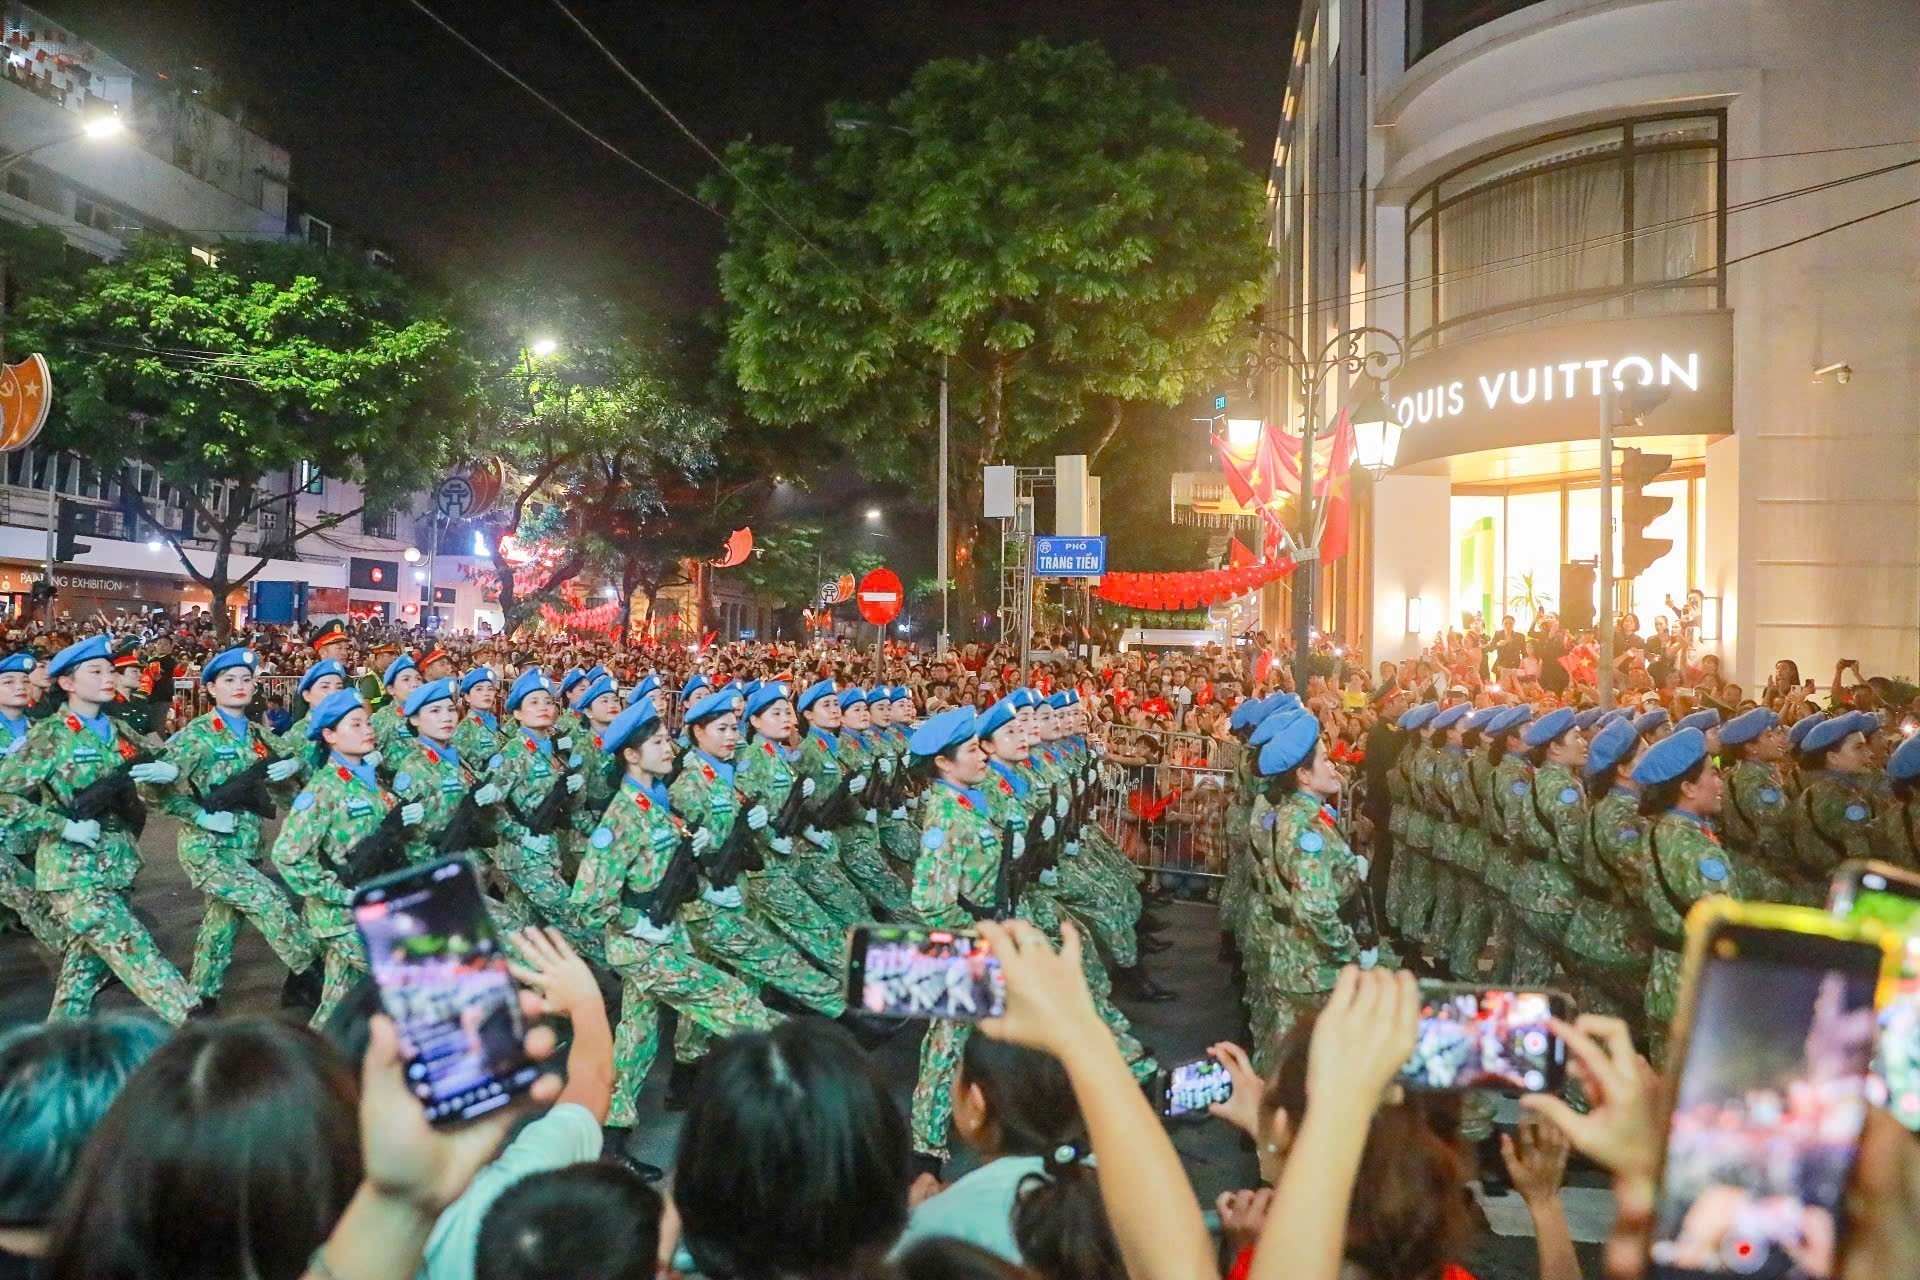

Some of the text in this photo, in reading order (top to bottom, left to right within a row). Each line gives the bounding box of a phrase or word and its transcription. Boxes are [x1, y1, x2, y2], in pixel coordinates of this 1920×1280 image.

[1392, 353, 1698, 429] OUIS VUITTON
[1065, 540, 1088, 550] PHỐ
[1040, 552, 1098, 569] TRÀNG TIỀN
[72, 577, 122, 591] EXHIBITION
